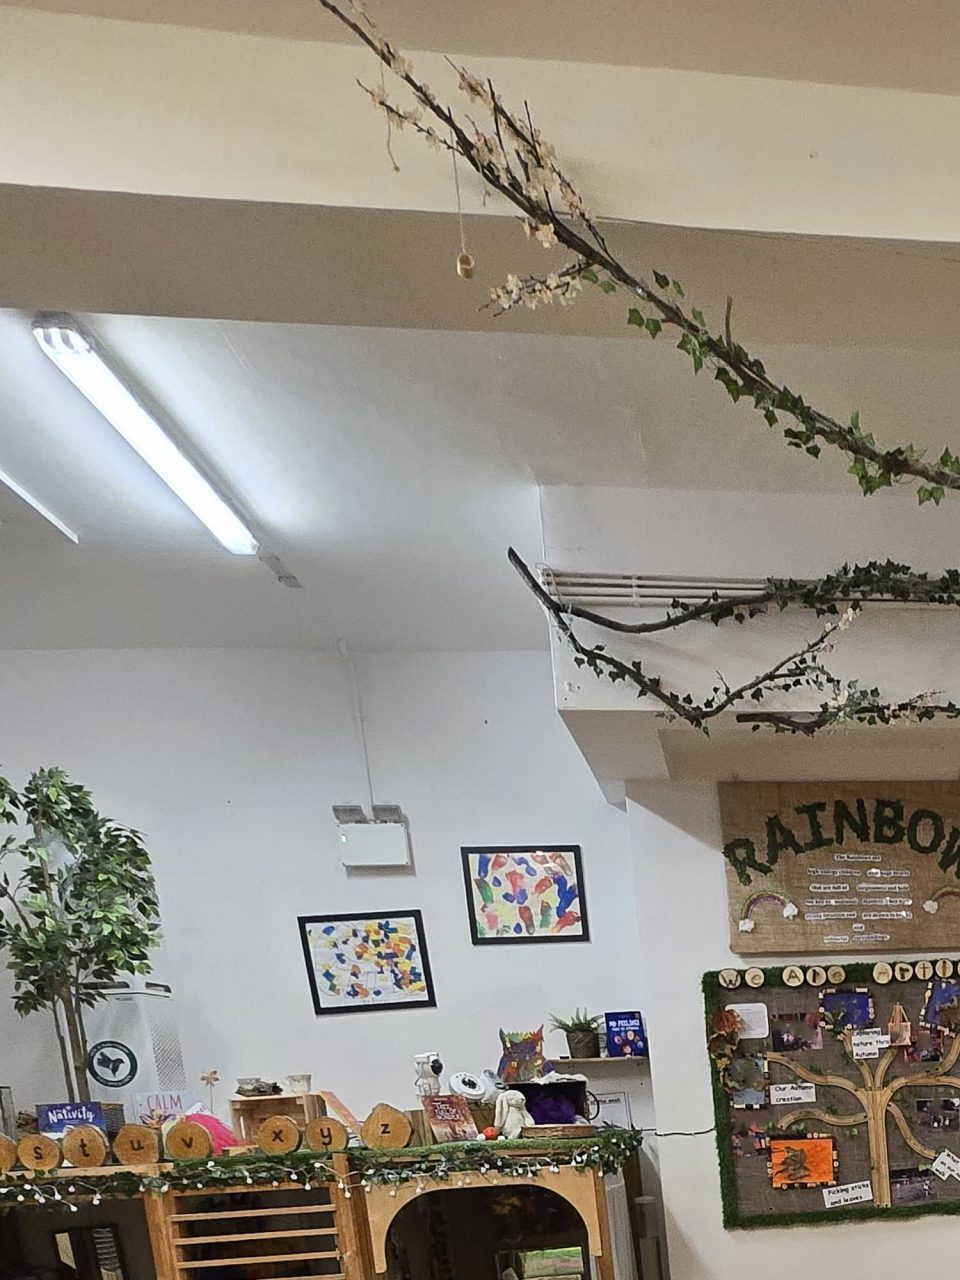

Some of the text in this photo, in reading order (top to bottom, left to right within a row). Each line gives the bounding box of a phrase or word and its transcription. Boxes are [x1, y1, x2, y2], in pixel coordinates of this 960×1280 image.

[720, 970, 762, 988] We
[146, 1093, 183, 1111] CALM
[47, 1105, 96, 1124] Nativity
[33, 1123, 391, 1160] s t u v x y z
